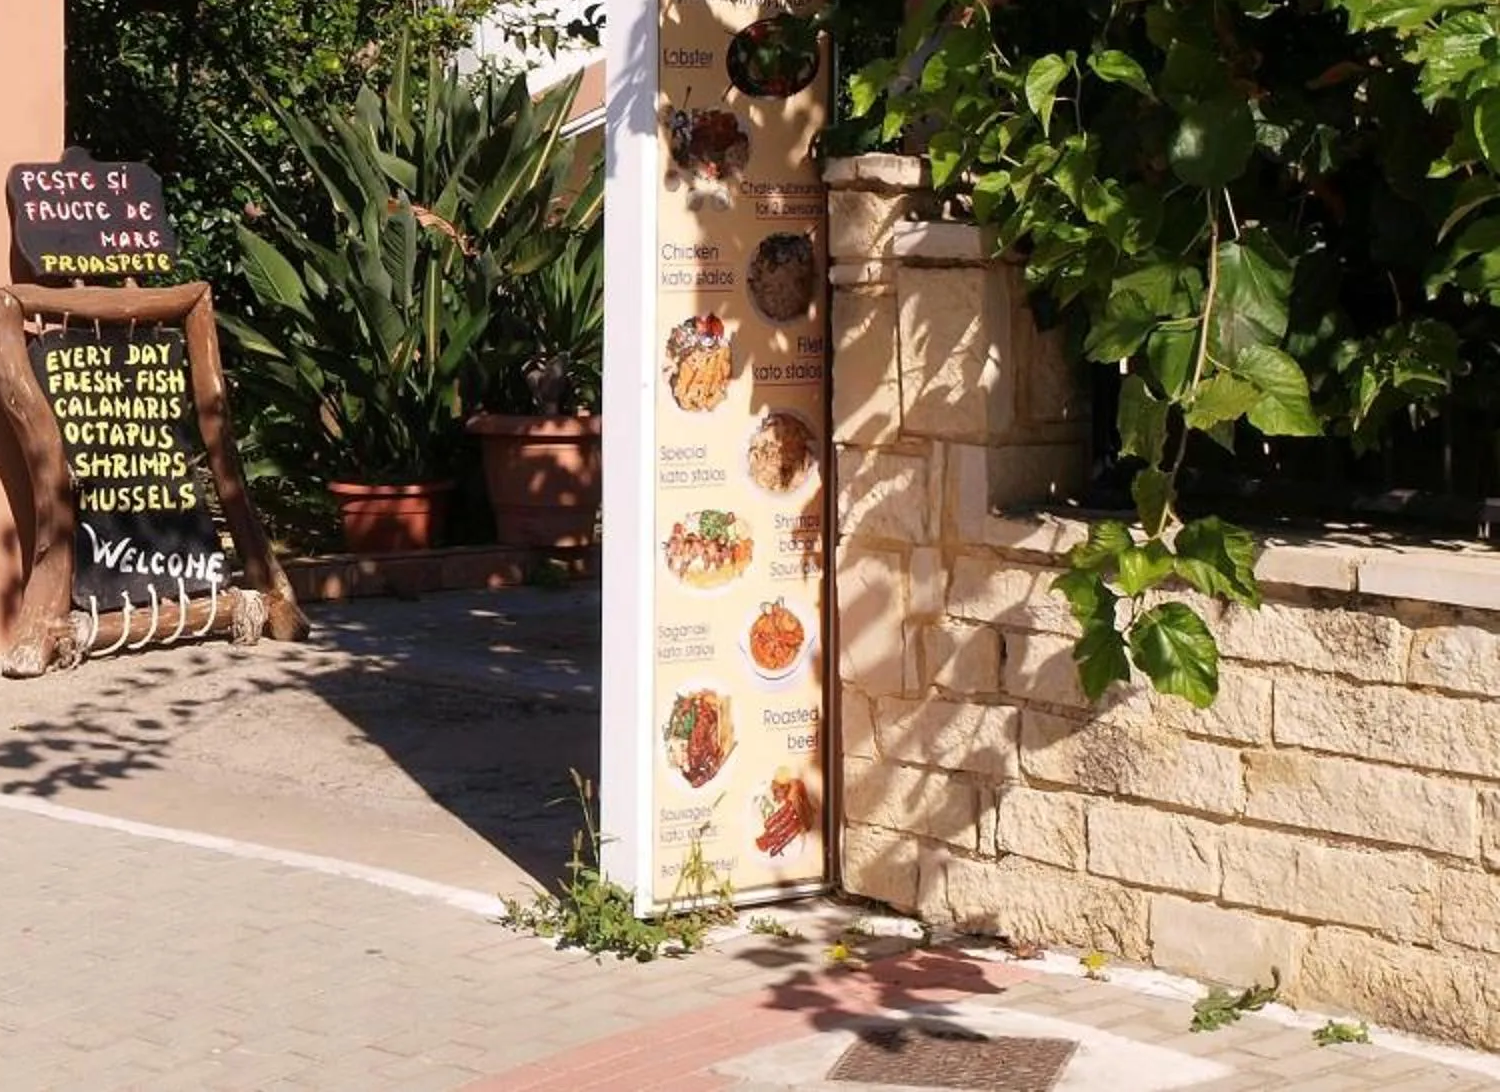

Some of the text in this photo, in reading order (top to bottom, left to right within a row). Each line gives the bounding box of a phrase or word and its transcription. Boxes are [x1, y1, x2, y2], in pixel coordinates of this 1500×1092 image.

[663, 49, 714, 66] Lobster
[24, 201, 153, 221] FRUCTE DE
[100, 230, 161, 249] MARE
[662, 243, 719, 261] Chicken
[41, 252, 171, 274] PROASPETE
[661, 267, 693, 286] kato
[45, 344, 172, 372] EVERY DAY
[754, 360, 822, 381] kato stalos
[53, 396, 182, 419] CALAMARIS
[64, 422, 175, 448] OCTAPUS
[660, 444, 707, 462] Special
[74, 453, 187, 479] SHRIMPS
[660, 468, 726, 484] kato stalos
[80, 482, 197, 512] MUSSELS
[763, 707, 820, 726] Roasted
[787, 731, 820, 750] beef
